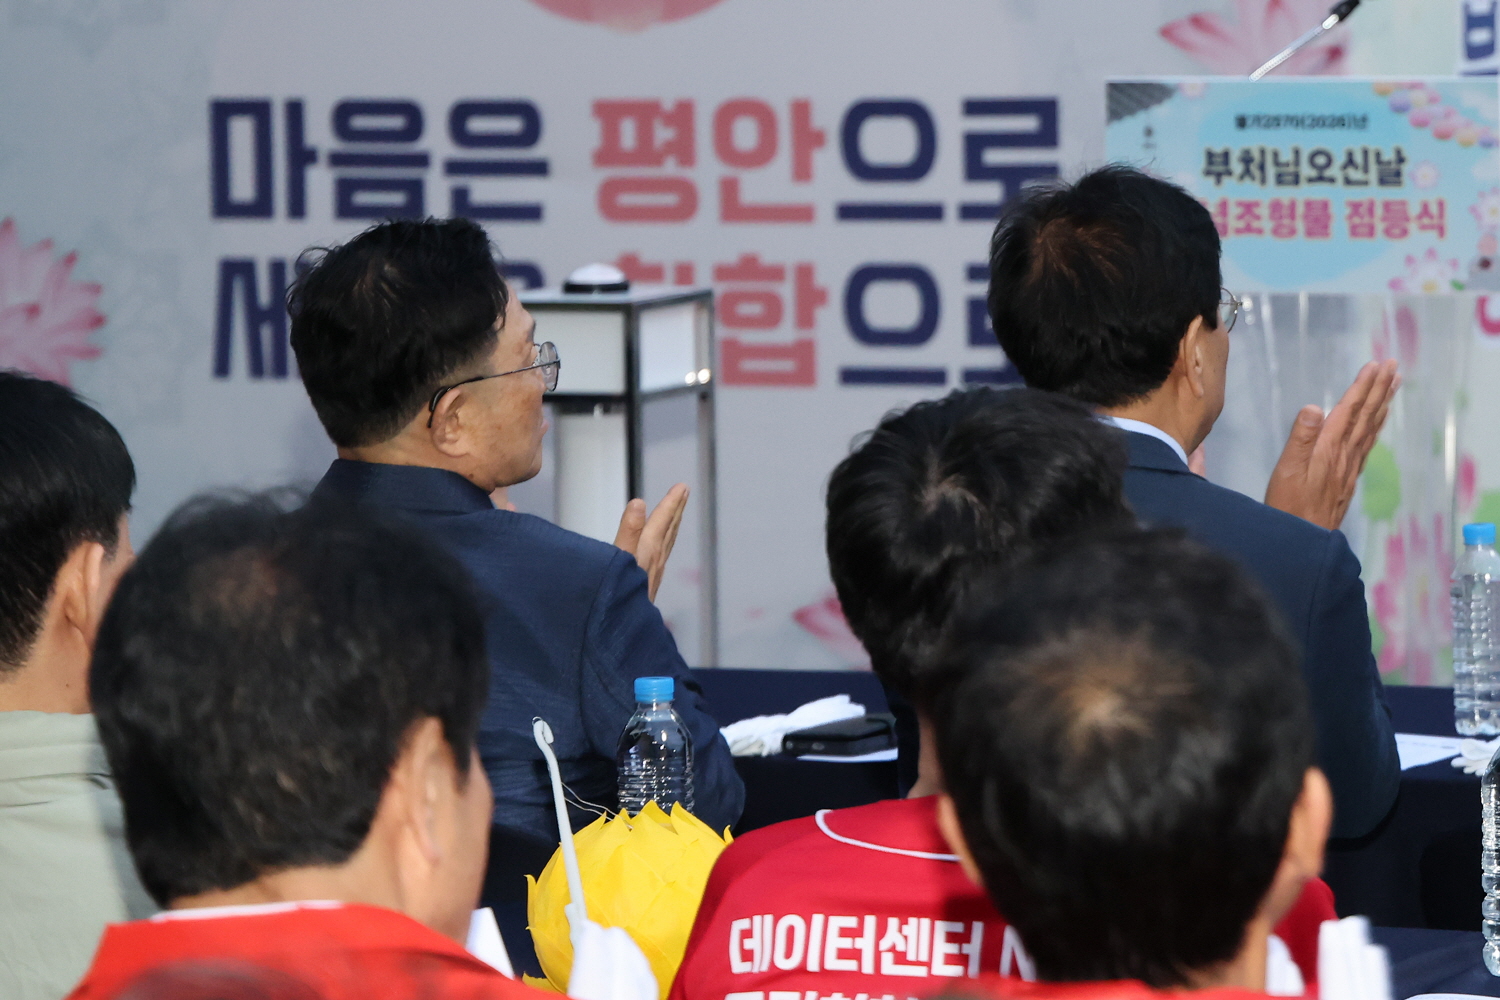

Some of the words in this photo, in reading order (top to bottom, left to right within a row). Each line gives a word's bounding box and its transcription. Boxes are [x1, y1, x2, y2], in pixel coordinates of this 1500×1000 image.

[209, 98, 549, 220] 마음은
[591, 97, 1062, 224] 평안으로
[1203, 147, 1406, 187] 부처님오신날
[1345, 198, 1446, 240] 점등식
[728, 913, 984, 979] 데이터센터
